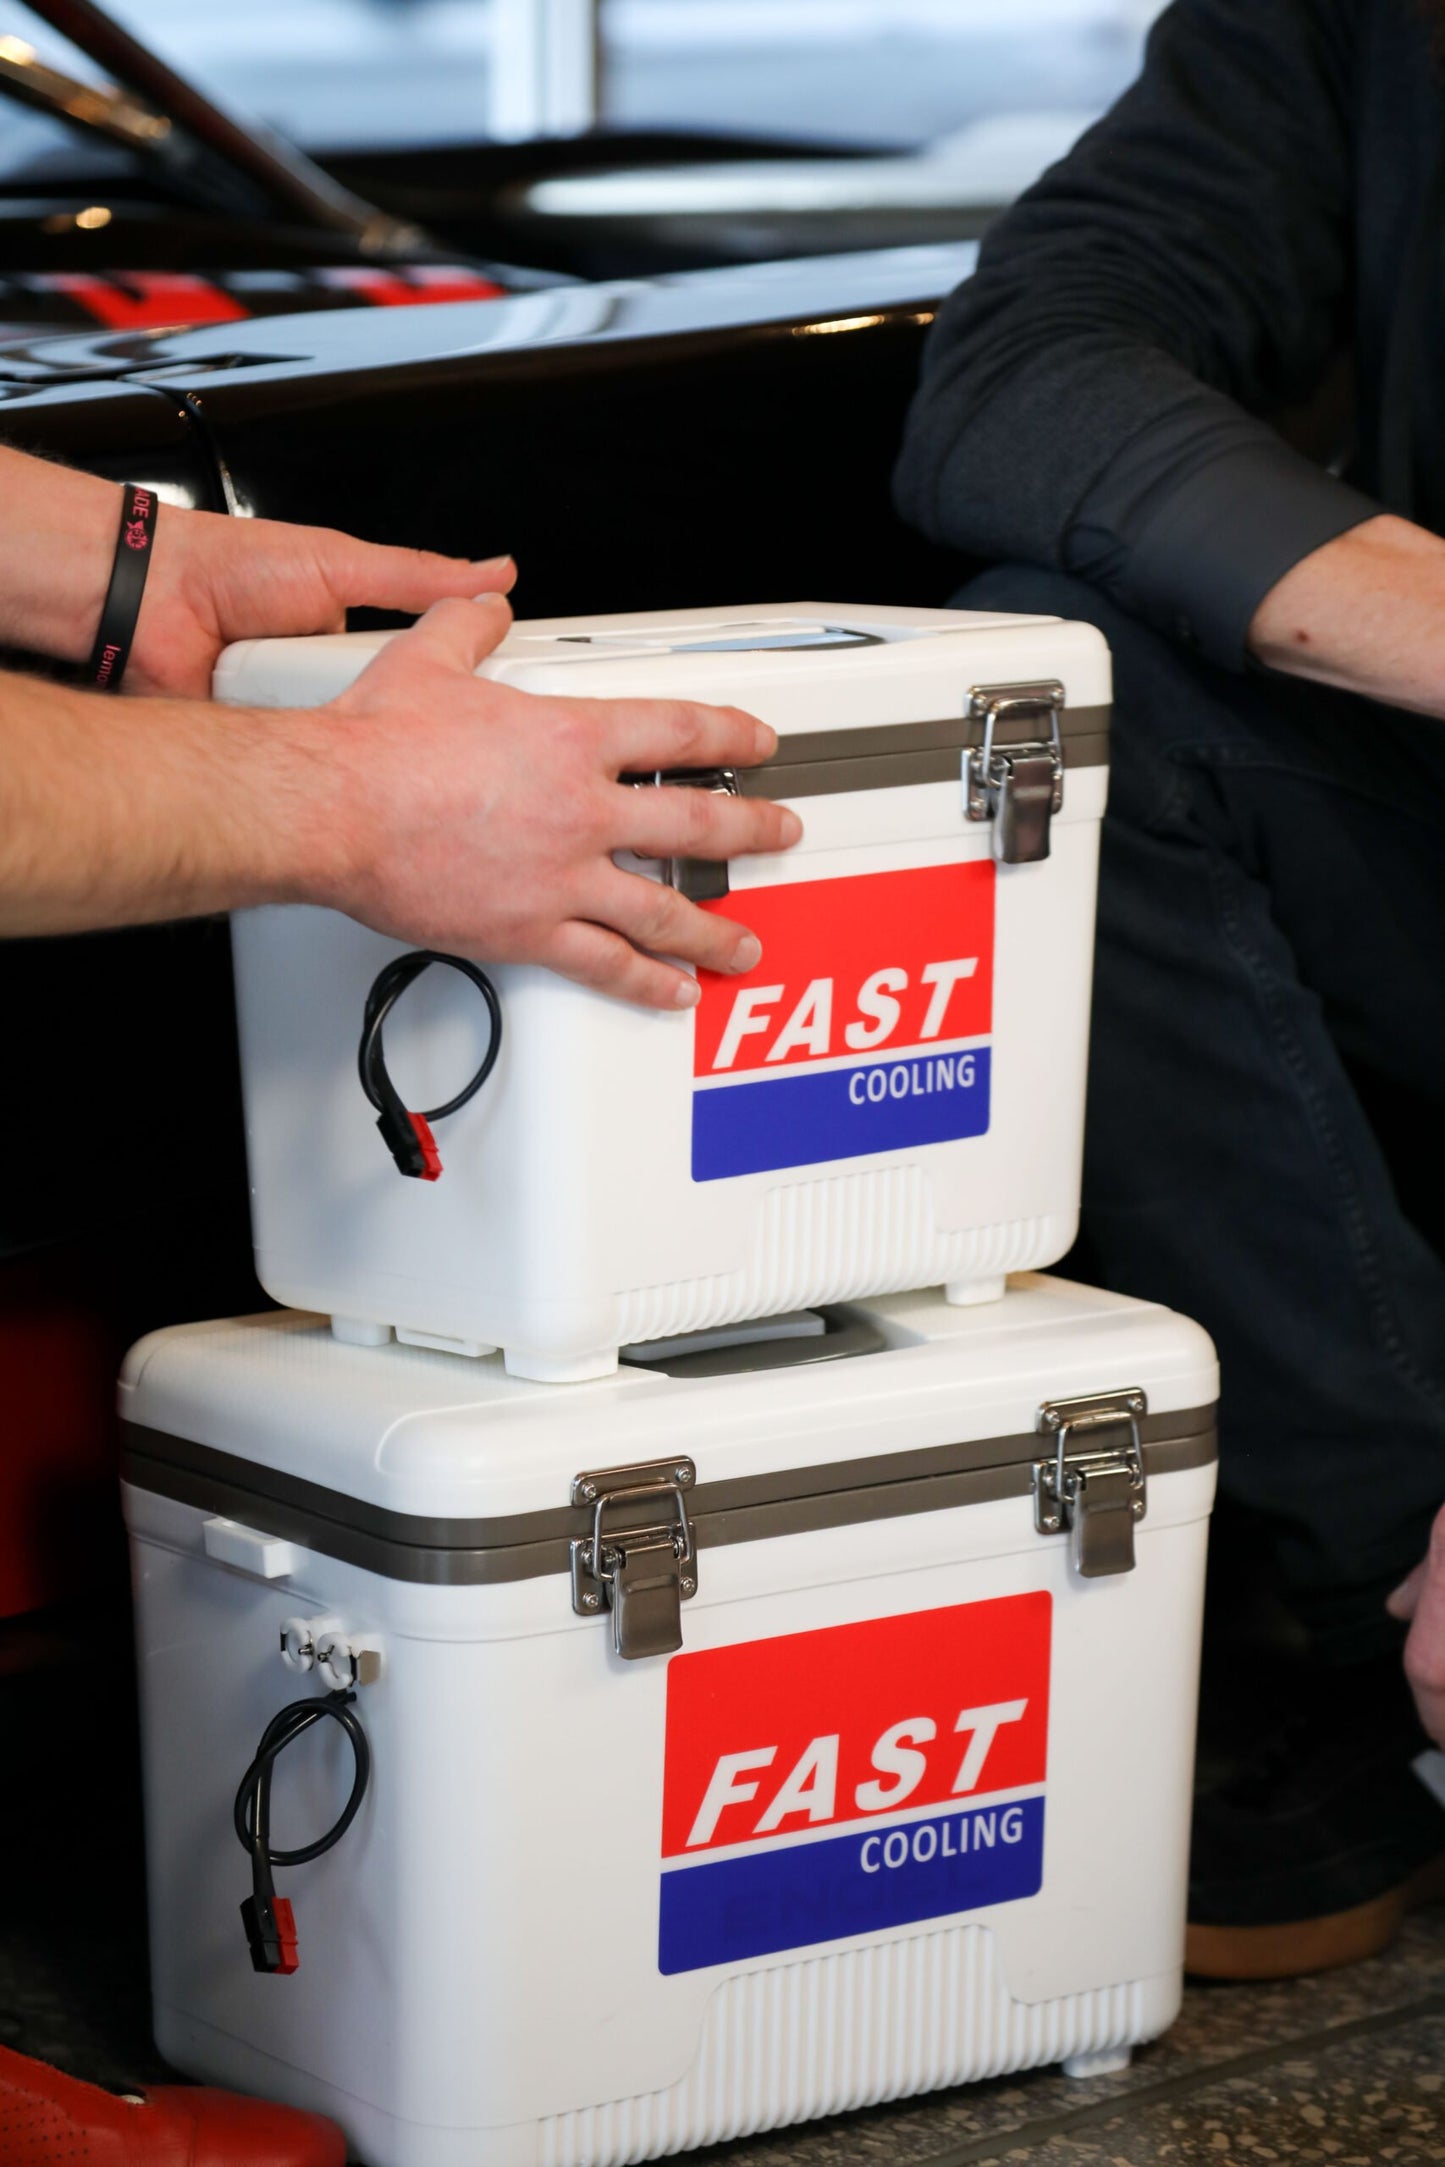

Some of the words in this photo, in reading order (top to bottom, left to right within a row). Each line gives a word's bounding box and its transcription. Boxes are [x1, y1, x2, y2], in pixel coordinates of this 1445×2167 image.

[712, 957, 979, 1070] FAST
[849, 1055, 975, 1105] COOLING
[685, 1698, 1029, 1847] FAST
[860, 1807, 1023, 1873] COOLING
